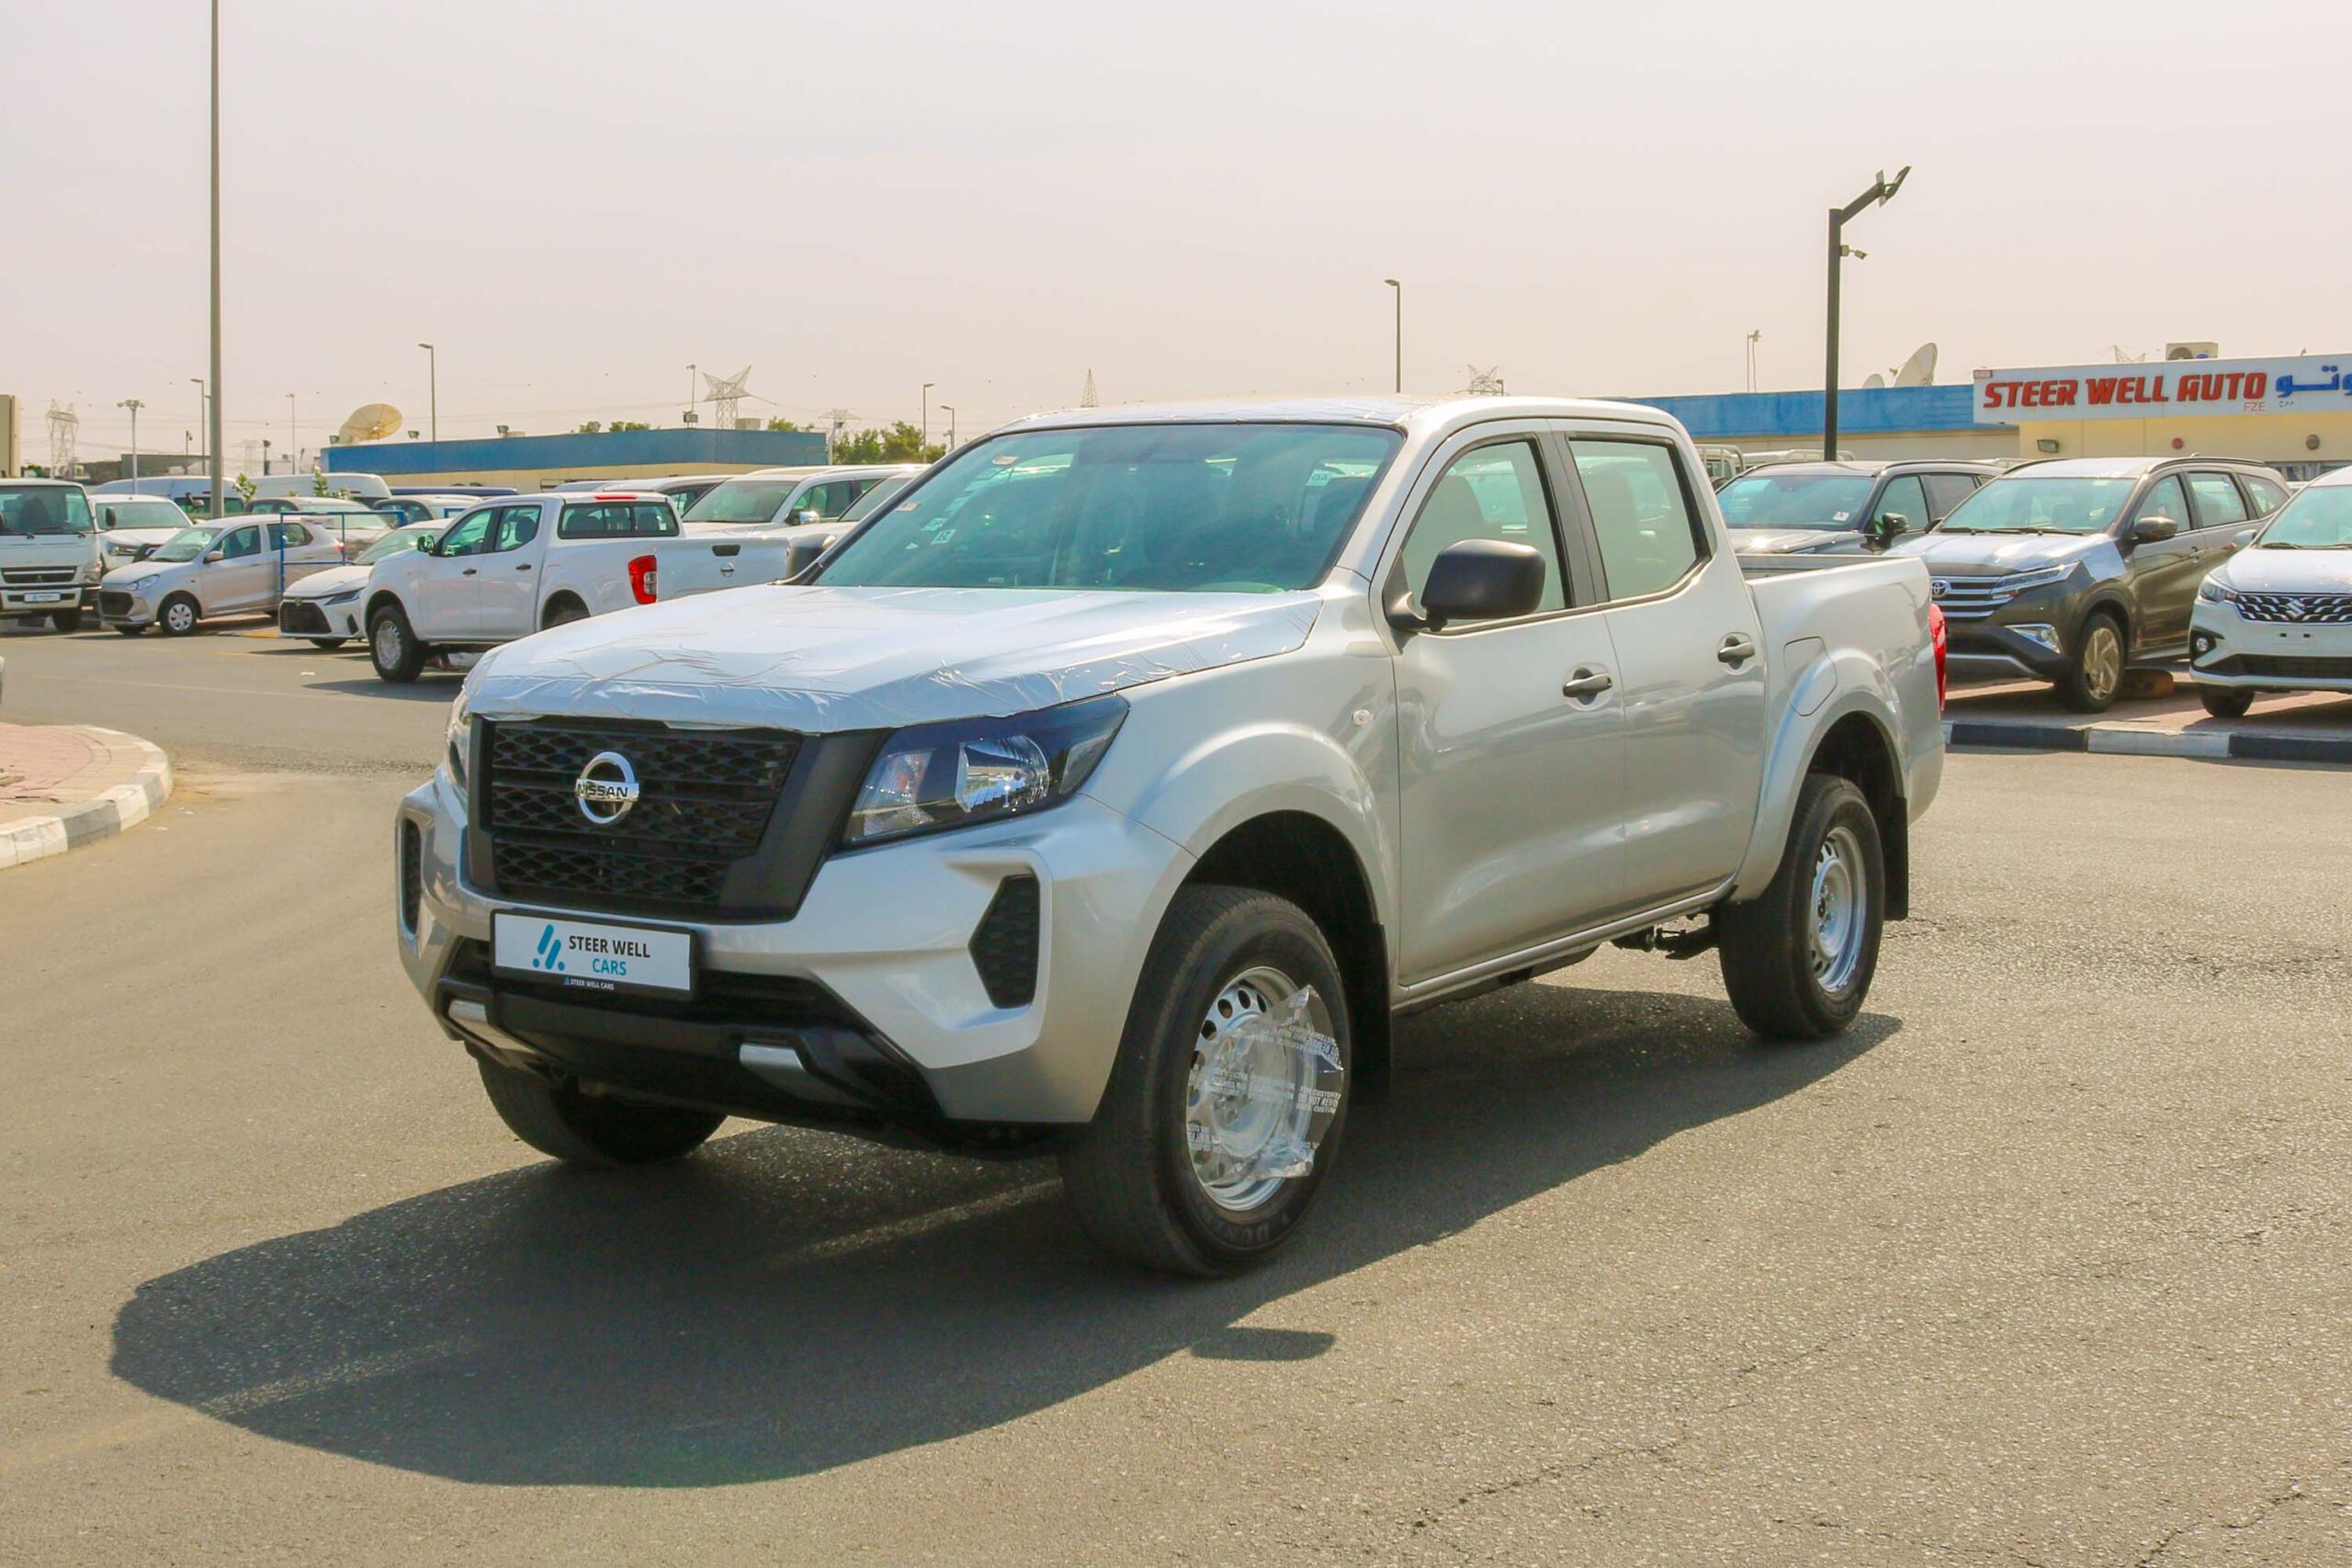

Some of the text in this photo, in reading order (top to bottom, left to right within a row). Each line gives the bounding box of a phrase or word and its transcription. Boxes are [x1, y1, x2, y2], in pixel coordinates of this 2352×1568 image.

[1983, 372, 2267, 409] STEER WELL AUTO
[2244, 401, 2267, 412] FZE
[576, 782, 628, 797] NISSAN
[569, 935, 650, 958] STEER WELL
[592, 958, 627, 976] CARS
